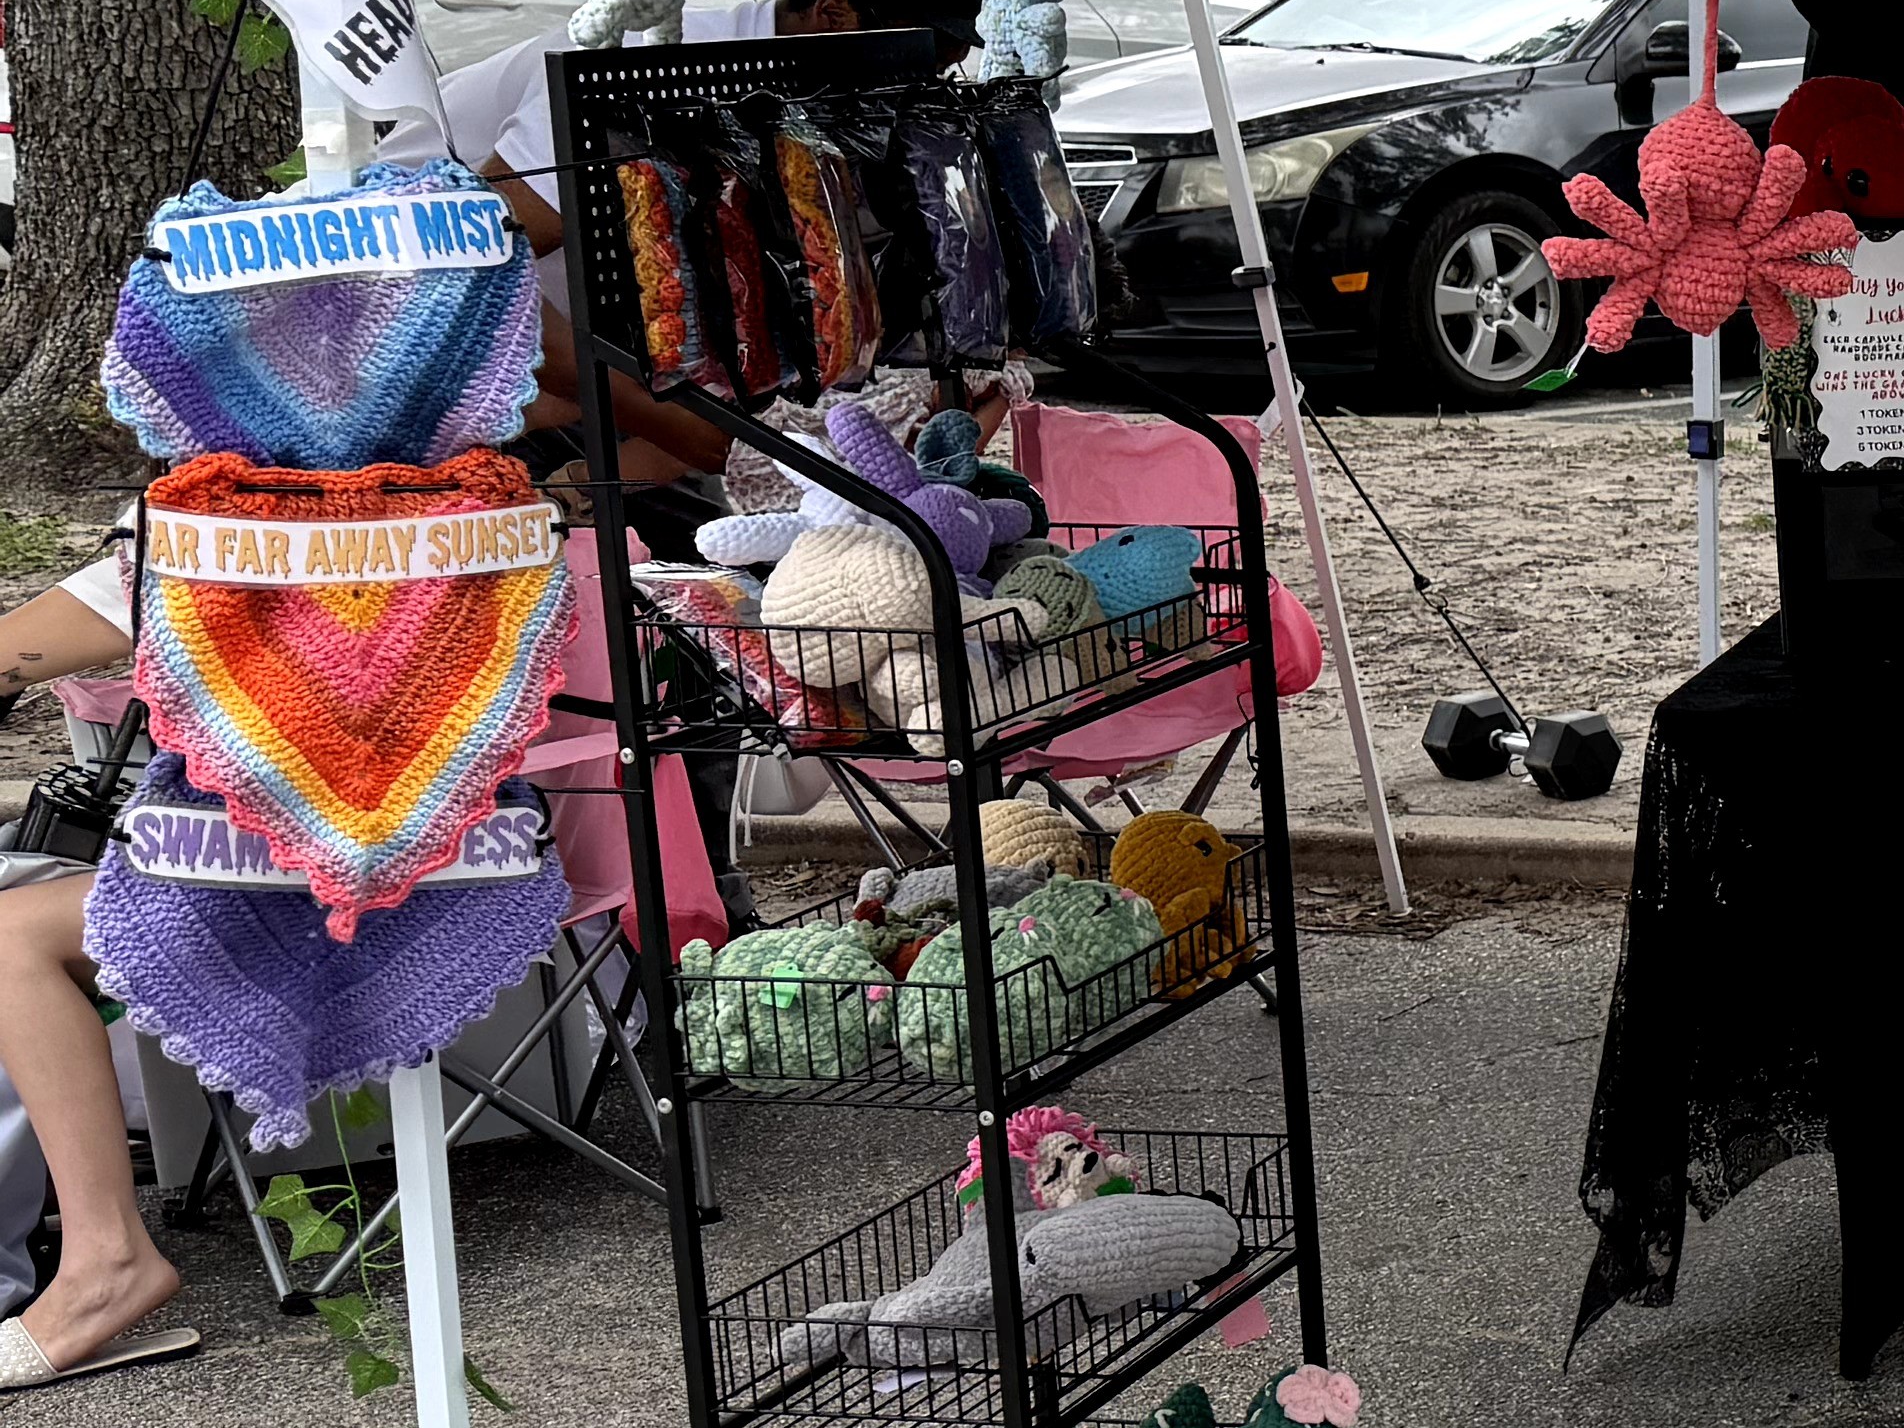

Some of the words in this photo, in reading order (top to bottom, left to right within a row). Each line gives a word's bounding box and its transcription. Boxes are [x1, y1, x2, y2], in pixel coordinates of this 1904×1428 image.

[165, 205, 399, 288] MIDNIGHT
[411, 199, 507, 257] MIST
[1823, 335, 1849, 344] EACH
[1854, 334, 1903, 344] CAPSULE
[1815, 381, 1847, 392] WINS
[1853, 379, 1876, 391] THE
[1823, 370, 1849, 381] ONE
[1854, 369, 1896, 380] LUCKY
[147, 520, 201, 574] AR
[214, 526, 292, 579] FAR
[305, 523, 417, 578] AWAY
[427, 507, 552, 574] SUNSET
[131, 811, 277, 876] SWAM
